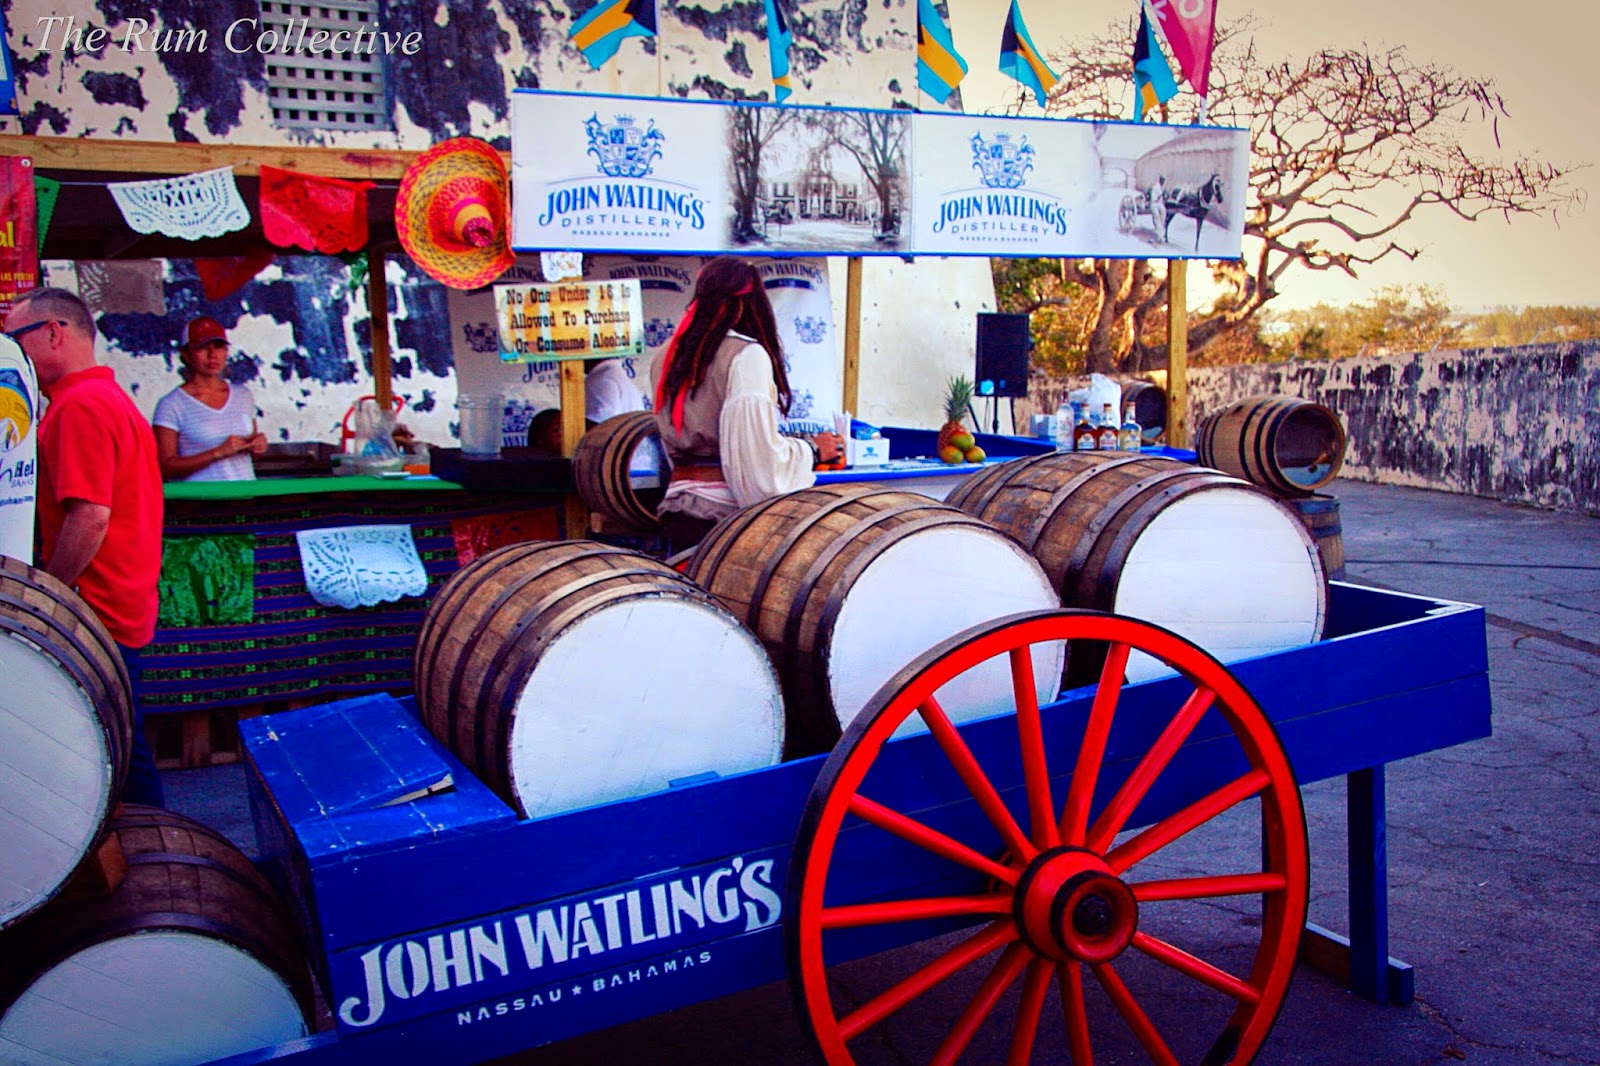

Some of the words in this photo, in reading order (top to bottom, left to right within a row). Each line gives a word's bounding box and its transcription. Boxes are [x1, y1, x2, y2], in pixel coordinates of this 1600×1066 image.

[538, 184, 600, 228] JOHN
[604, 183, 706, 231] WATLING'S
[932, 194, 983, 234] JOHN
[986, 193, 1067, 237] WATLING'S
[561, 213, 684, 231] DISTILLERY
[951, 221, 1049, 236] DISTILLERY
[505, 288, 523, 305] No
[529, 287, 552, 304] One
[558, 284, 591, 303] Under
[599, 283, 614, 300] 18
[620, 282, 631, 299] Is
[510, 312, 556, 330] Allowed
[562, 310, 578, 327] To
[583, 308, 631, 325] Purchase
[514, 338, 529, 354] Or
[536, 336, 586, 352] Consume
[592, 331, 631, 349] Alcohol
[338, 919, 510, 1028] JOHN
[514, 856, 783, 971] WATLING'S
[456, 987, 563, 1027] NASSAU
[592, 951, 713, 994] BAHAMAS
